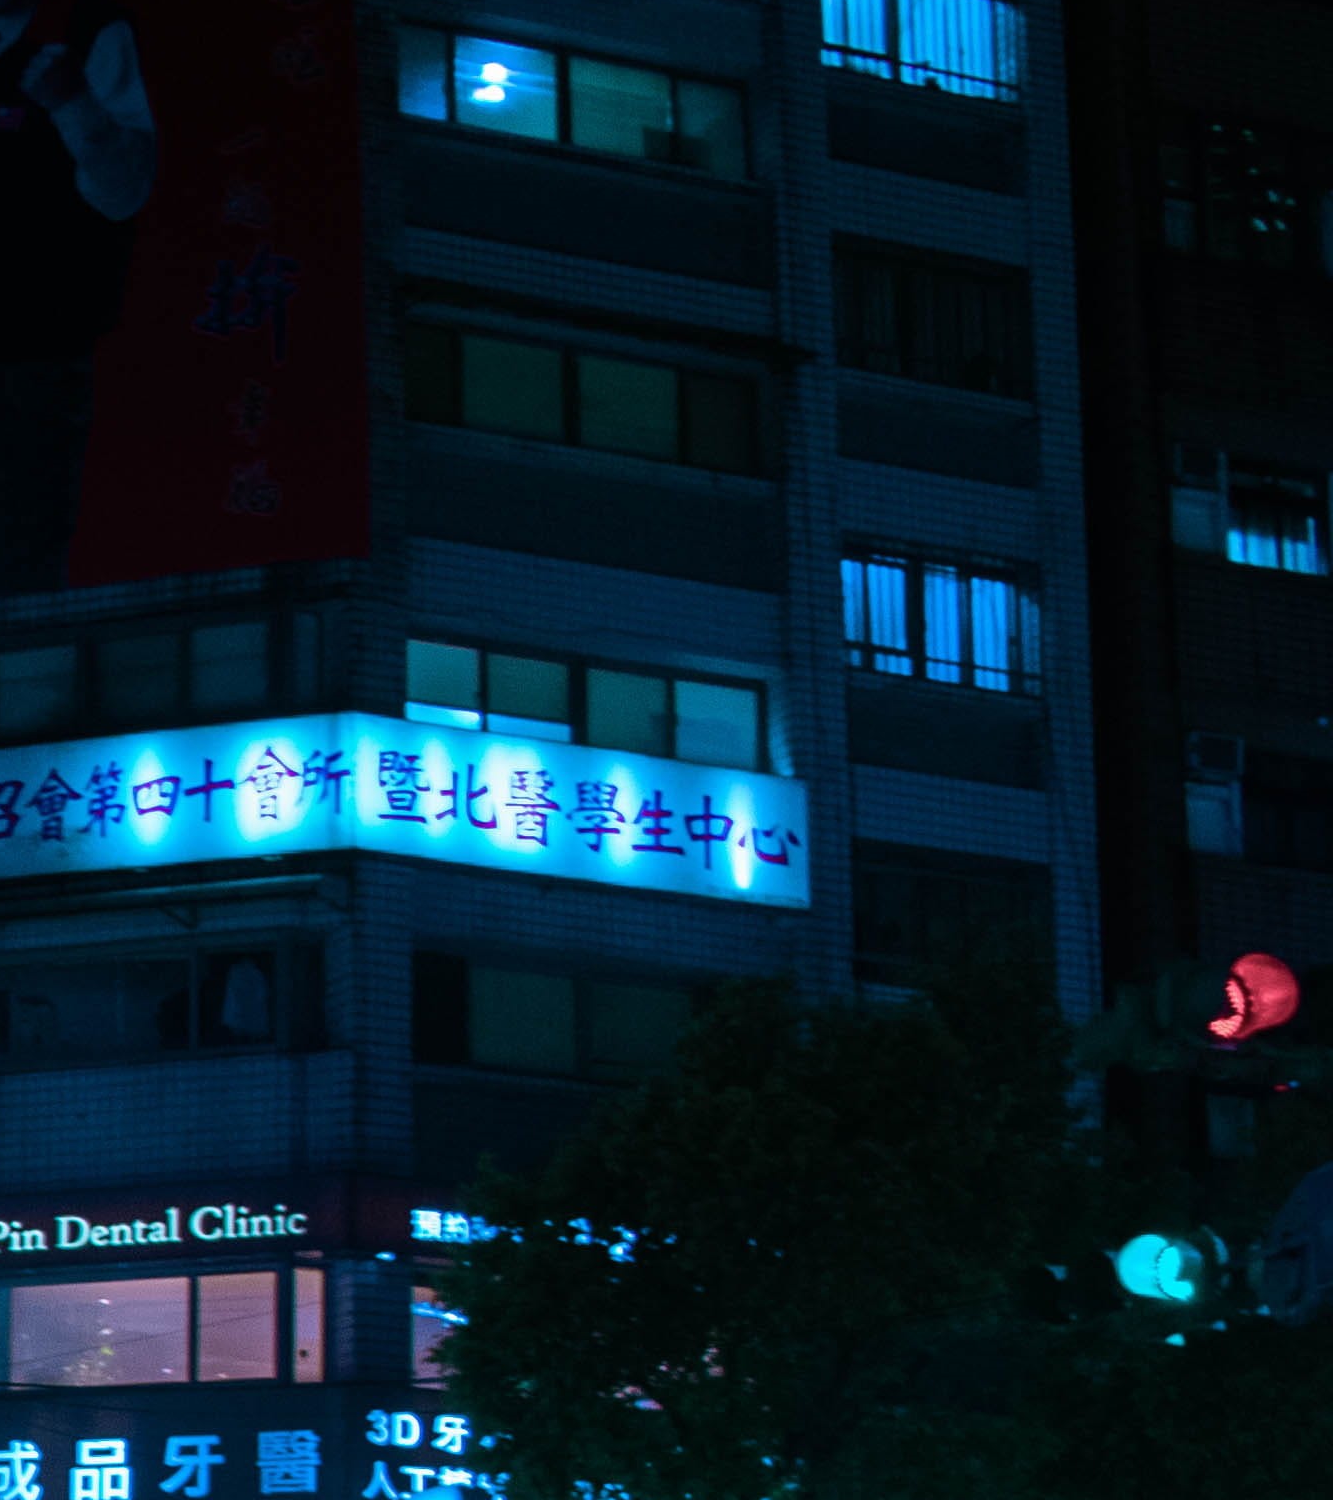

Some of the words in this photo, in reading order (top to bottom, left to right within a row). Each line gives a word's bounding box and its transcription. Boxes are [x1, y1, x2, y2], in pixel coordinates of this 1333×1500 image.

[375, 744, 805, 870] 暨北醫學生中心
[53, 1206, 182, 1251] Dental
[187, 1201, 308, 1244] Clinic
